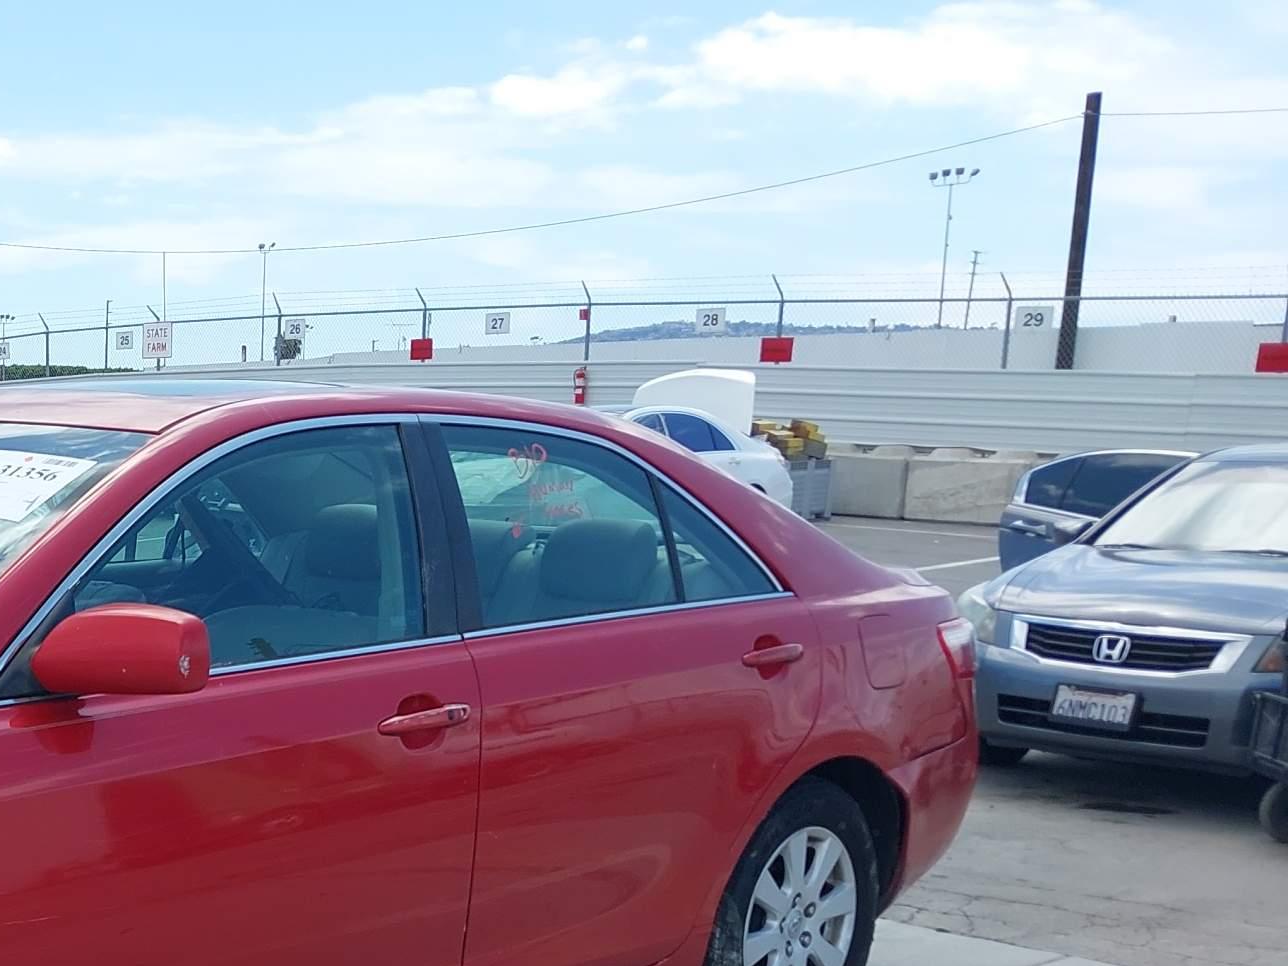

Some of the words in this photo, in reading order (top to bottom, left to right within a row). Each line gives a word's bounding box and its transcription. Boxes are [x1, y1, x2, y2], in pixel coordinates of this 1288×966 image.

[490, 317, 505, 330] 27
[702, 314, 719, 327] 28
[1023, 312, 1044, 327] 29
[146, 327, 168, 338] STATE
[289, 323, 301, 335] 26
[119, 336, 130, 346] 25
[147, 342, 167, 353] FARM
